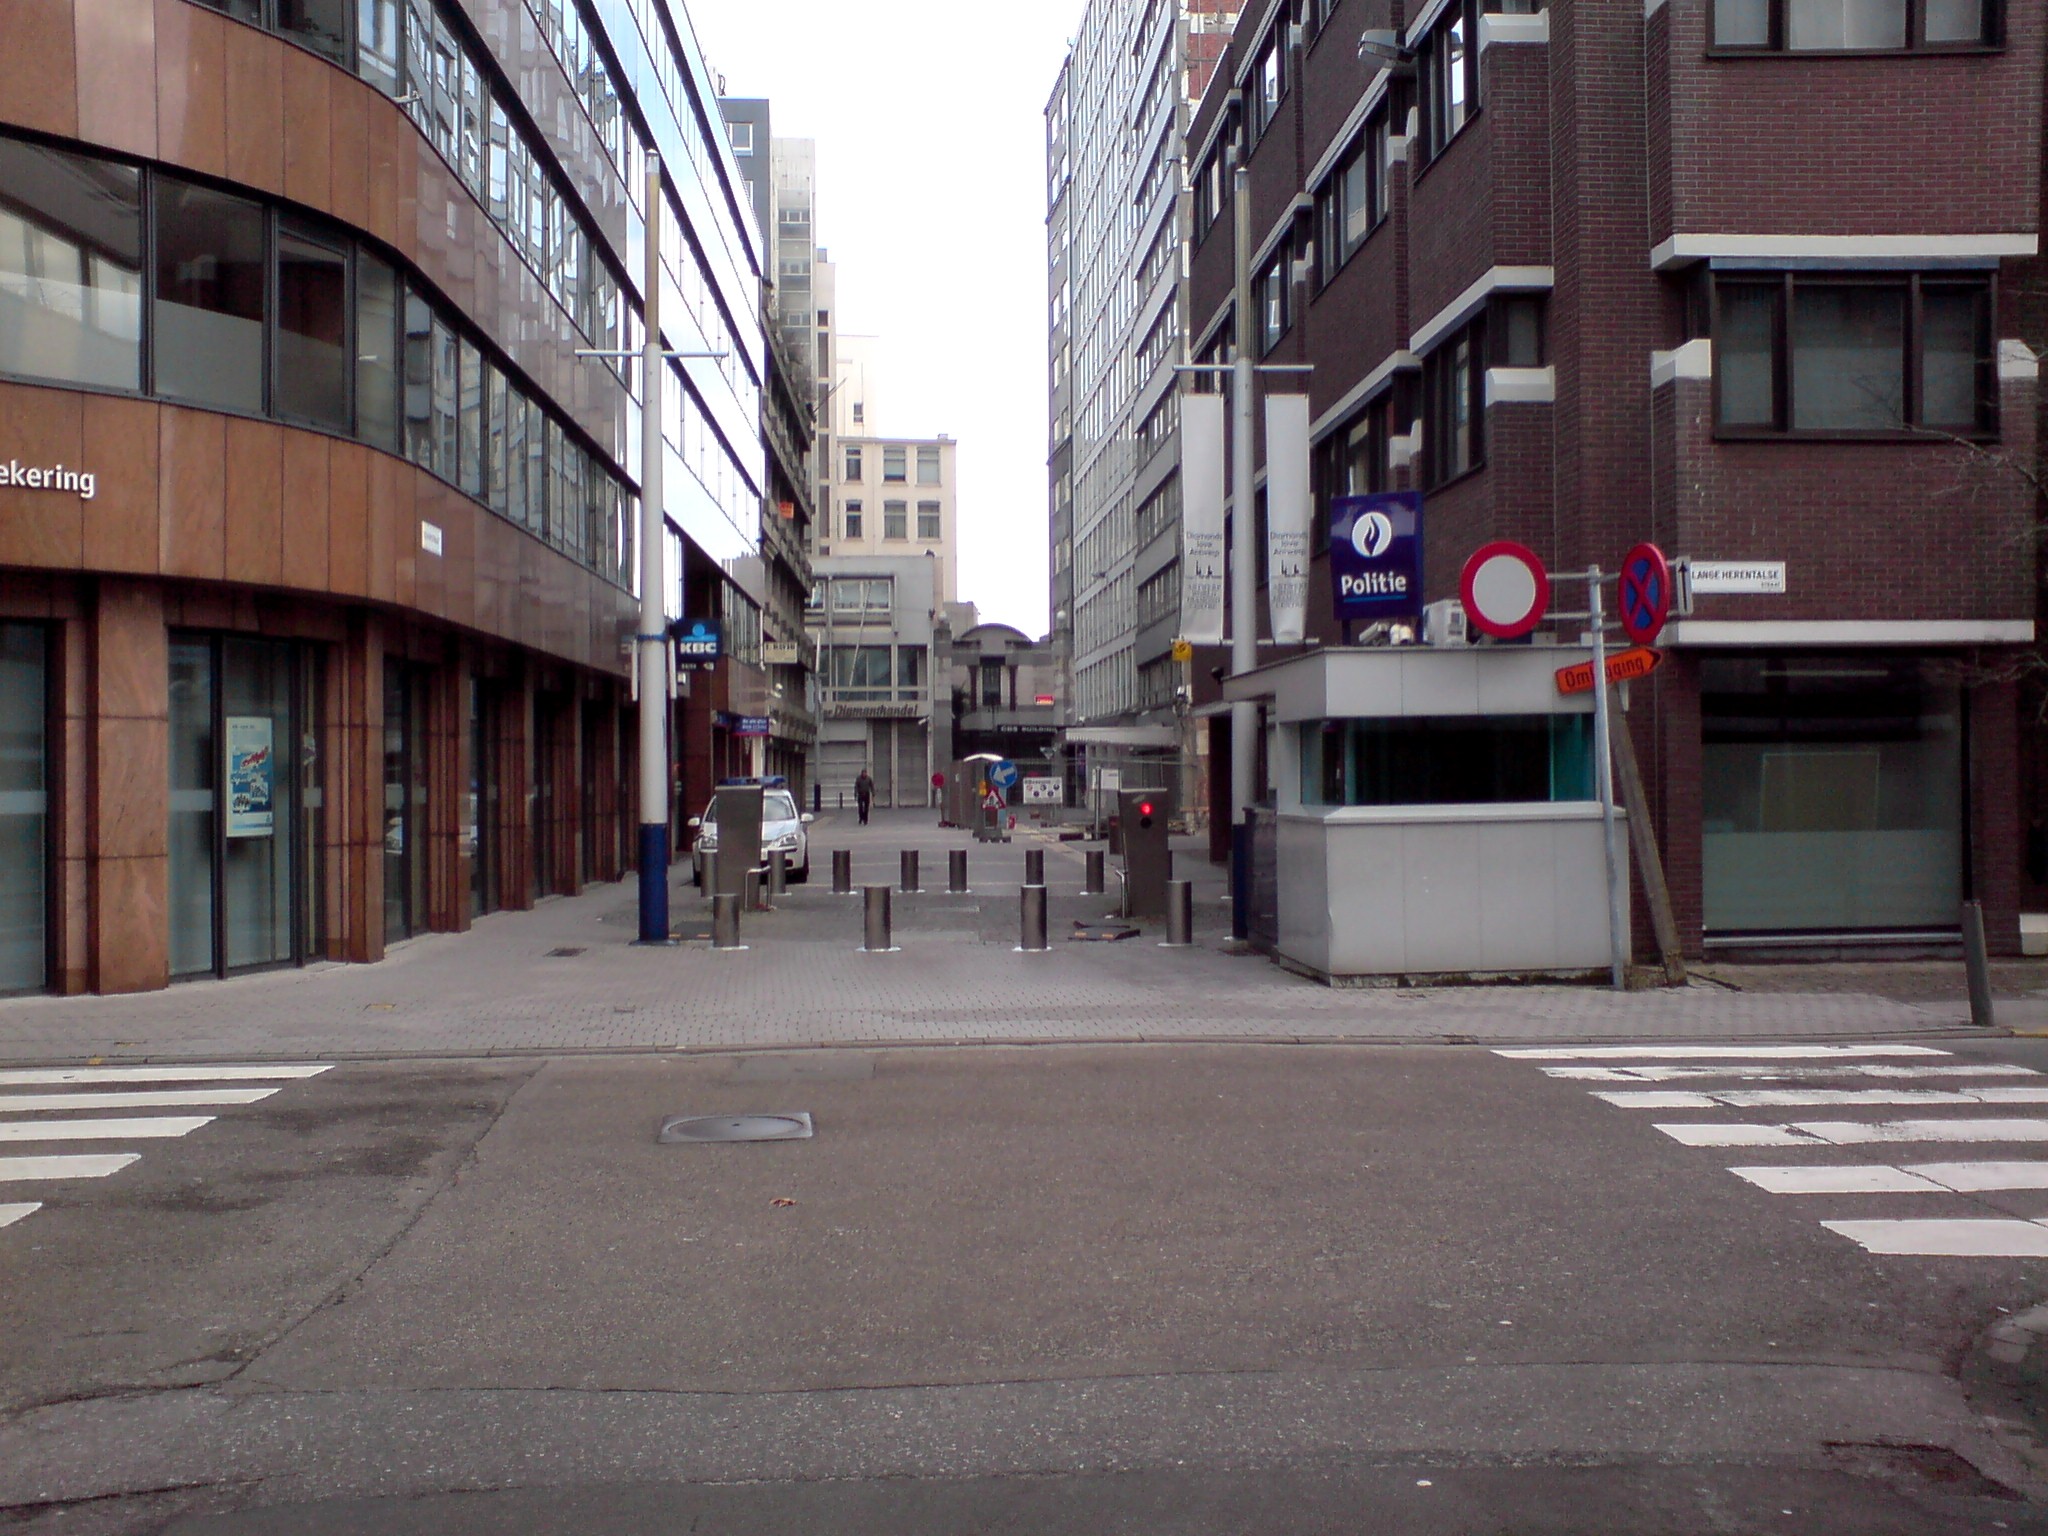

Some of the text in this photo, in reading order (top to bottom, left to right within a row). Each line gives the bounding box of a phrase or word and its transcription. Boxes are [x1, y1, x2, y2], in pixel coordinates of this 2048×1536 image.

[1691, 570, 1779, 580] LANGE HERENTALSE
[1341, 571, 1407, 596] Politie
[680, 642, 717, 654] KBC
[834, 703, 919, 718] Diamanthandel
